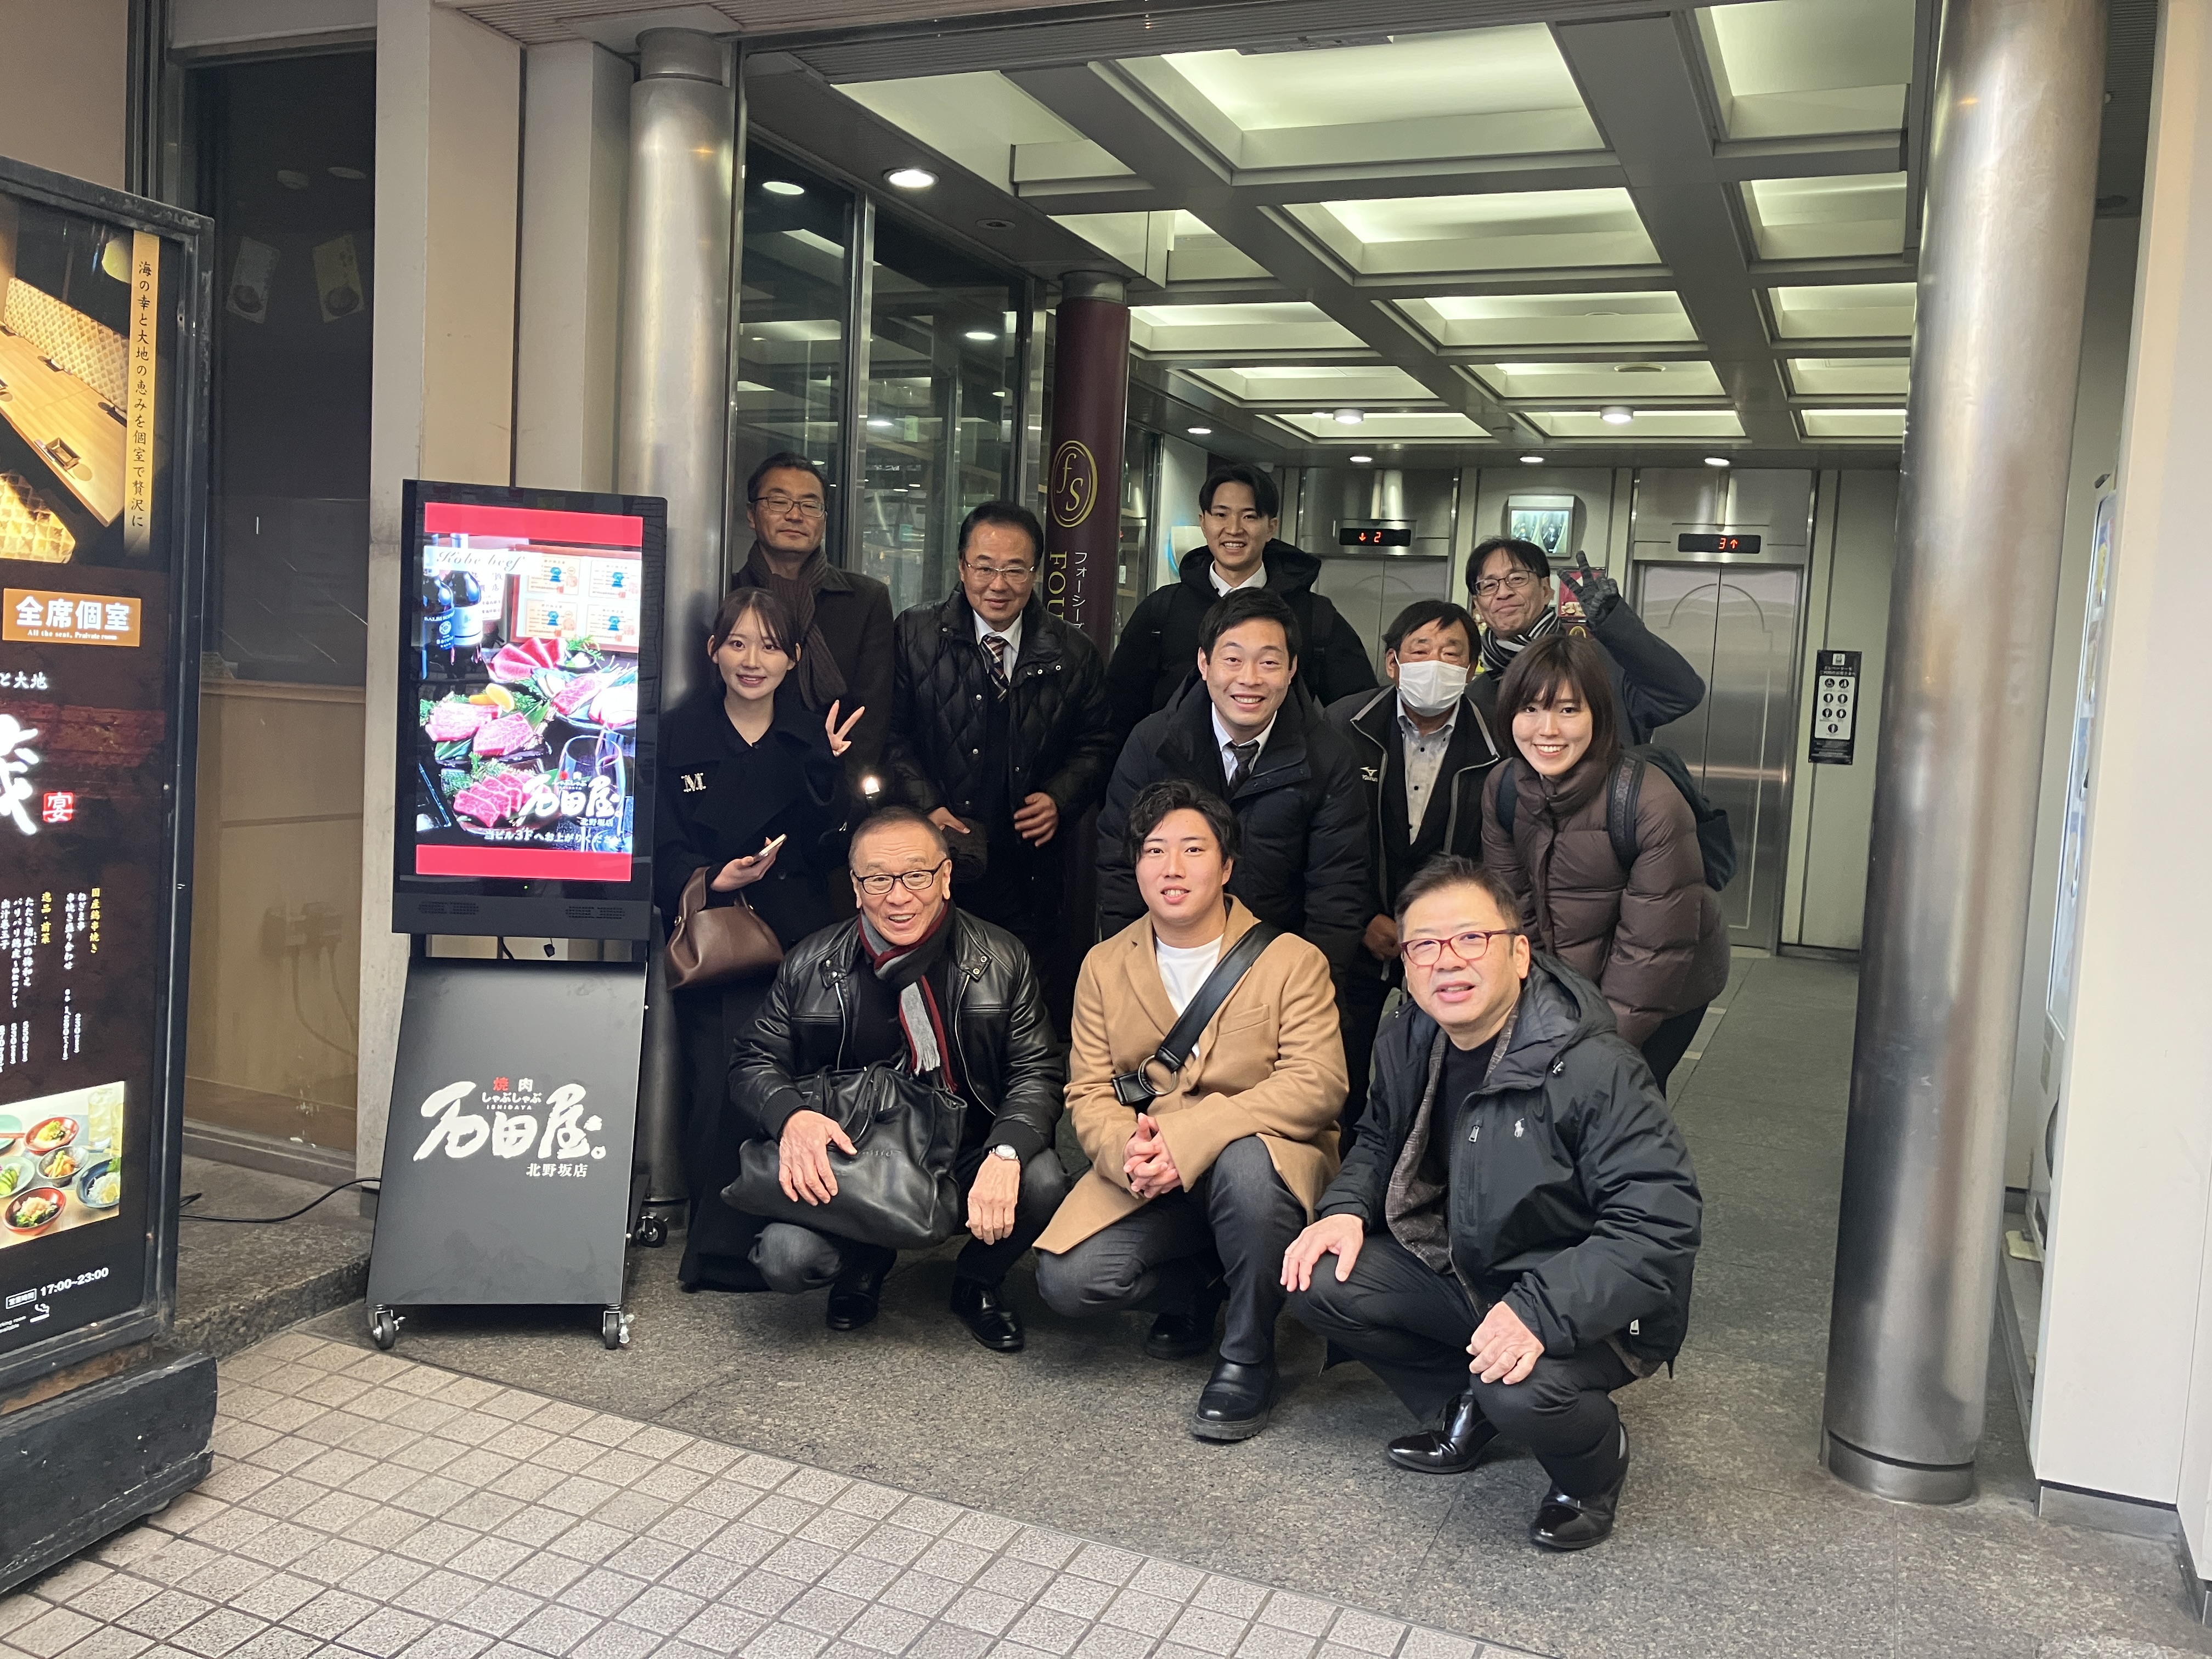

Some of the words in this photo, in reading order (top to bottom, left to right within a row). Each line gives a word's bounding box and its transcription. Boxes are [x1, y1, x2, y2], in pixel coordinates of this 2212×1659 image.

[131, 261, 151, 527] 海の幸と大地の恵みを個室で贅沢に
[1374, 532, 1381, 543] 2
[1719, 538, 1726, 549] 3
[437, 551, 481, 565] Kobe
[488, 554, 525, 572] beef
[15, 596, 130, 631] 全席個室
[681, 772, 707, 792] M
[43, 792, 74, 822] 宴
[493, 1077, 533, 1092] 焼肉
[482, 1092, 543, 1103] しゃぶしゃぶ
[526, 1163, 588, 1178] 北野坂店
